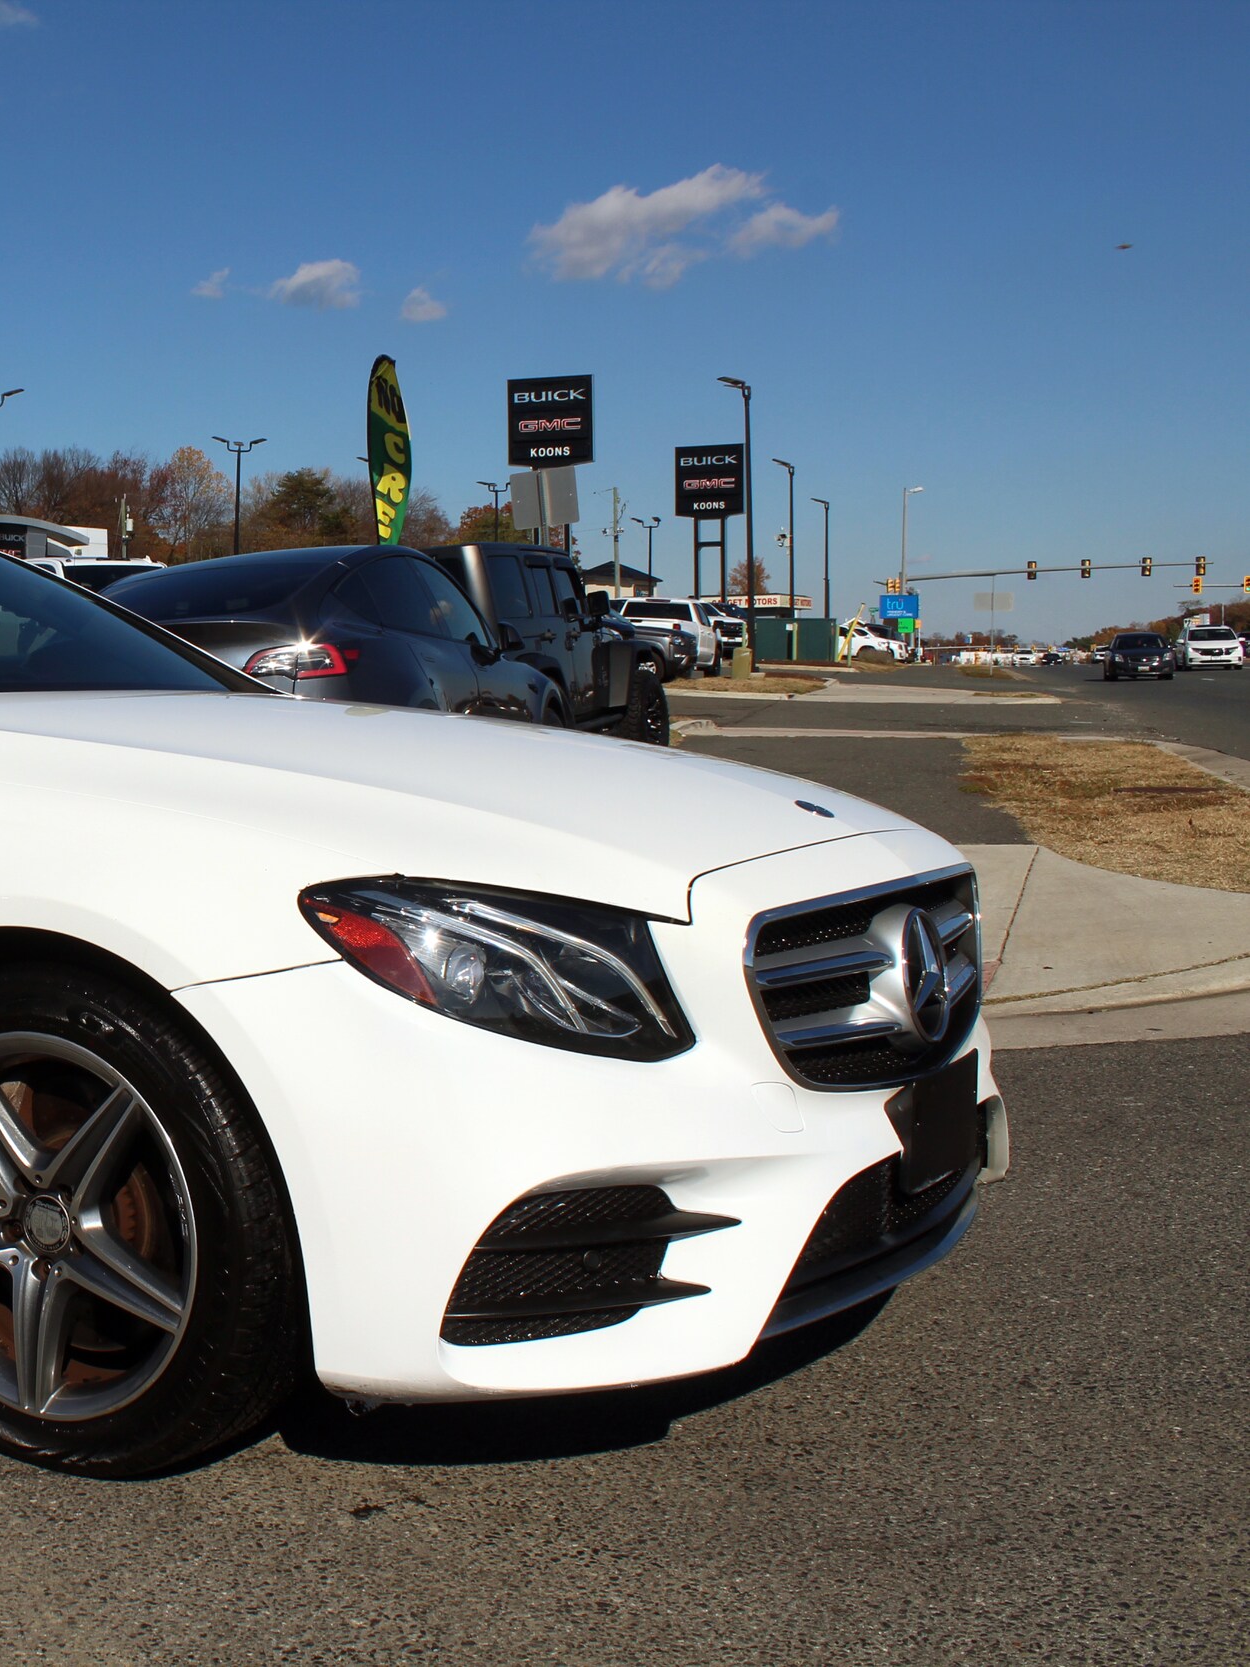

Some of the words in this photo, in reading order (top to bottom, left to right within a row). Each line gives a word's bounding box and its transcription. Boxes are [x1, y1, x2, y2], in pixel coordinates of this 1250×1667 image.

[513, 388, 586, 404] BUICK
[518, 417, 581, 433] GMC
[530, 446, 570, 458] KOONS
[680, 455, 738, 467] BUICK
[683, 477, 735, 490] GMC
[693, 501, 726, 510] KOONS
